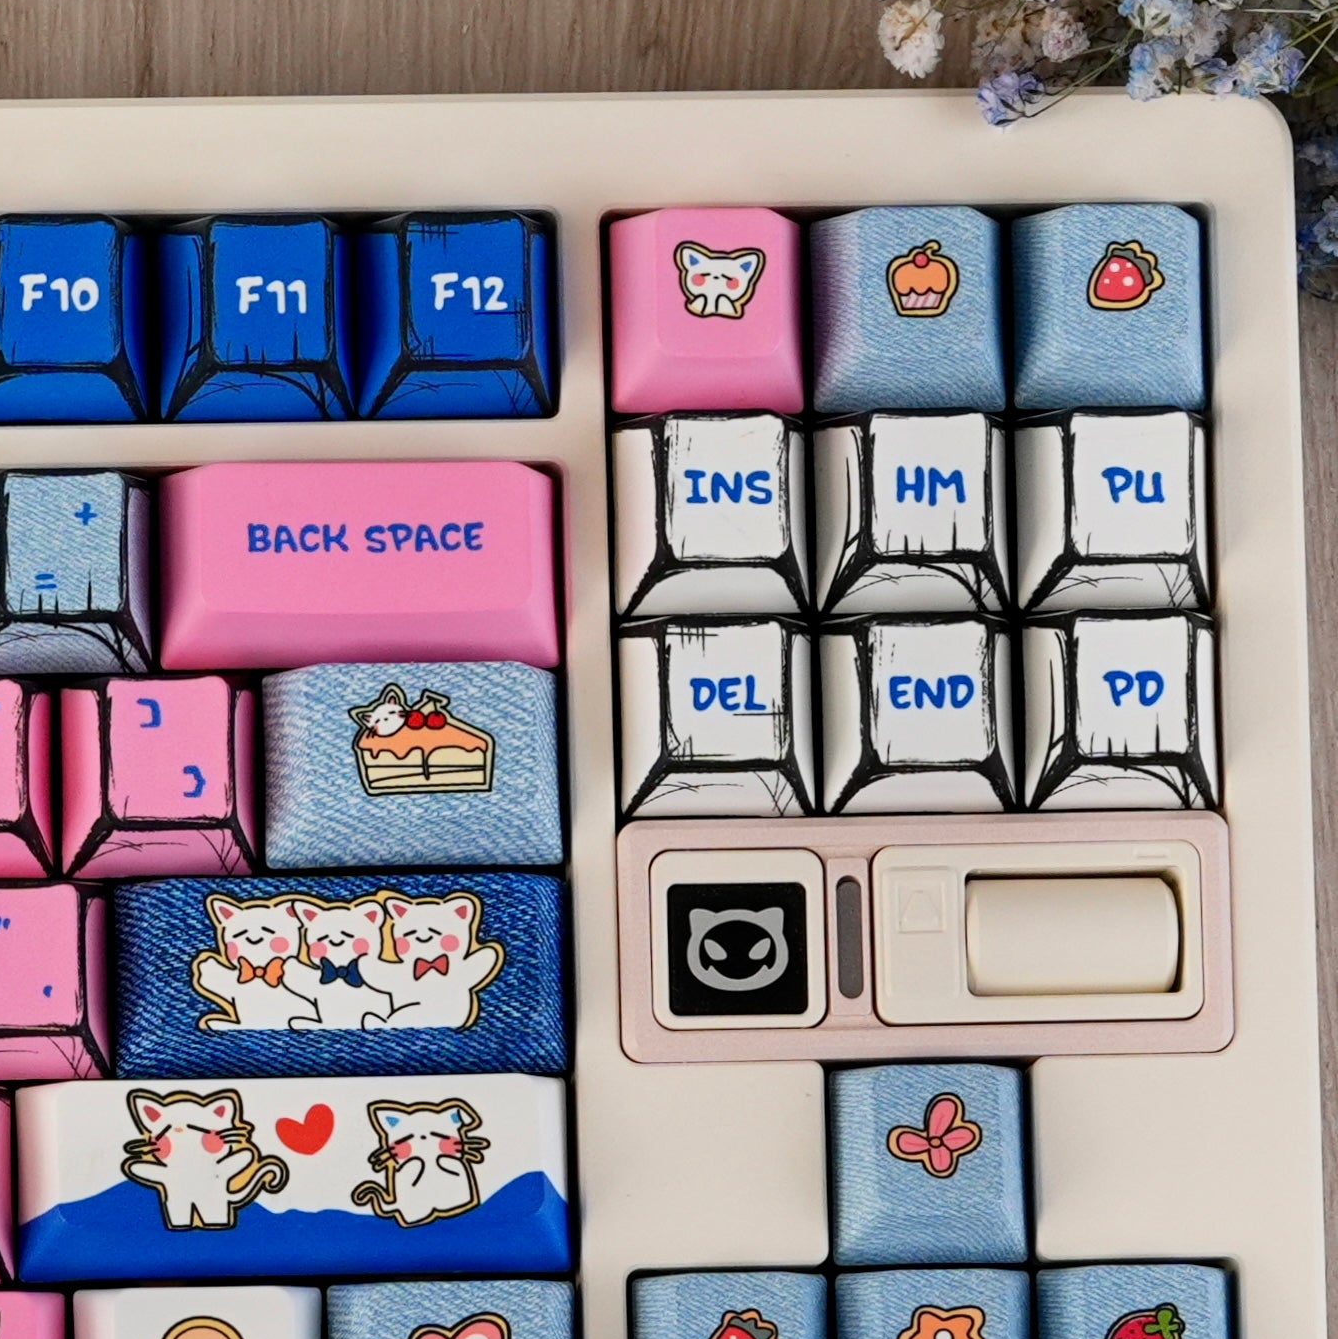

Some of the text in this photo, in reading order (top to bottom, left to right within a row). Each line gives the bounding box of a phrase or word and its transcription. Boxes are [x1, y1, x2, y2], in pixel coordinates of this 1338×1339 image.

[19, 273, 100, 312] F10
[236, 276, 307, 314] F11
[431, 272, 508, 311] F12
[684, 469, 773, 505] INS
[896, 466, 966, 507] HM
[1102, 466, 1165, 504] PU
[248, 522, 484, 553] BACK SPACE
[689, 674, 767, 712] DEL
[889, 674, 975, 710] END
[1103, 670, 1165, 707] PD
